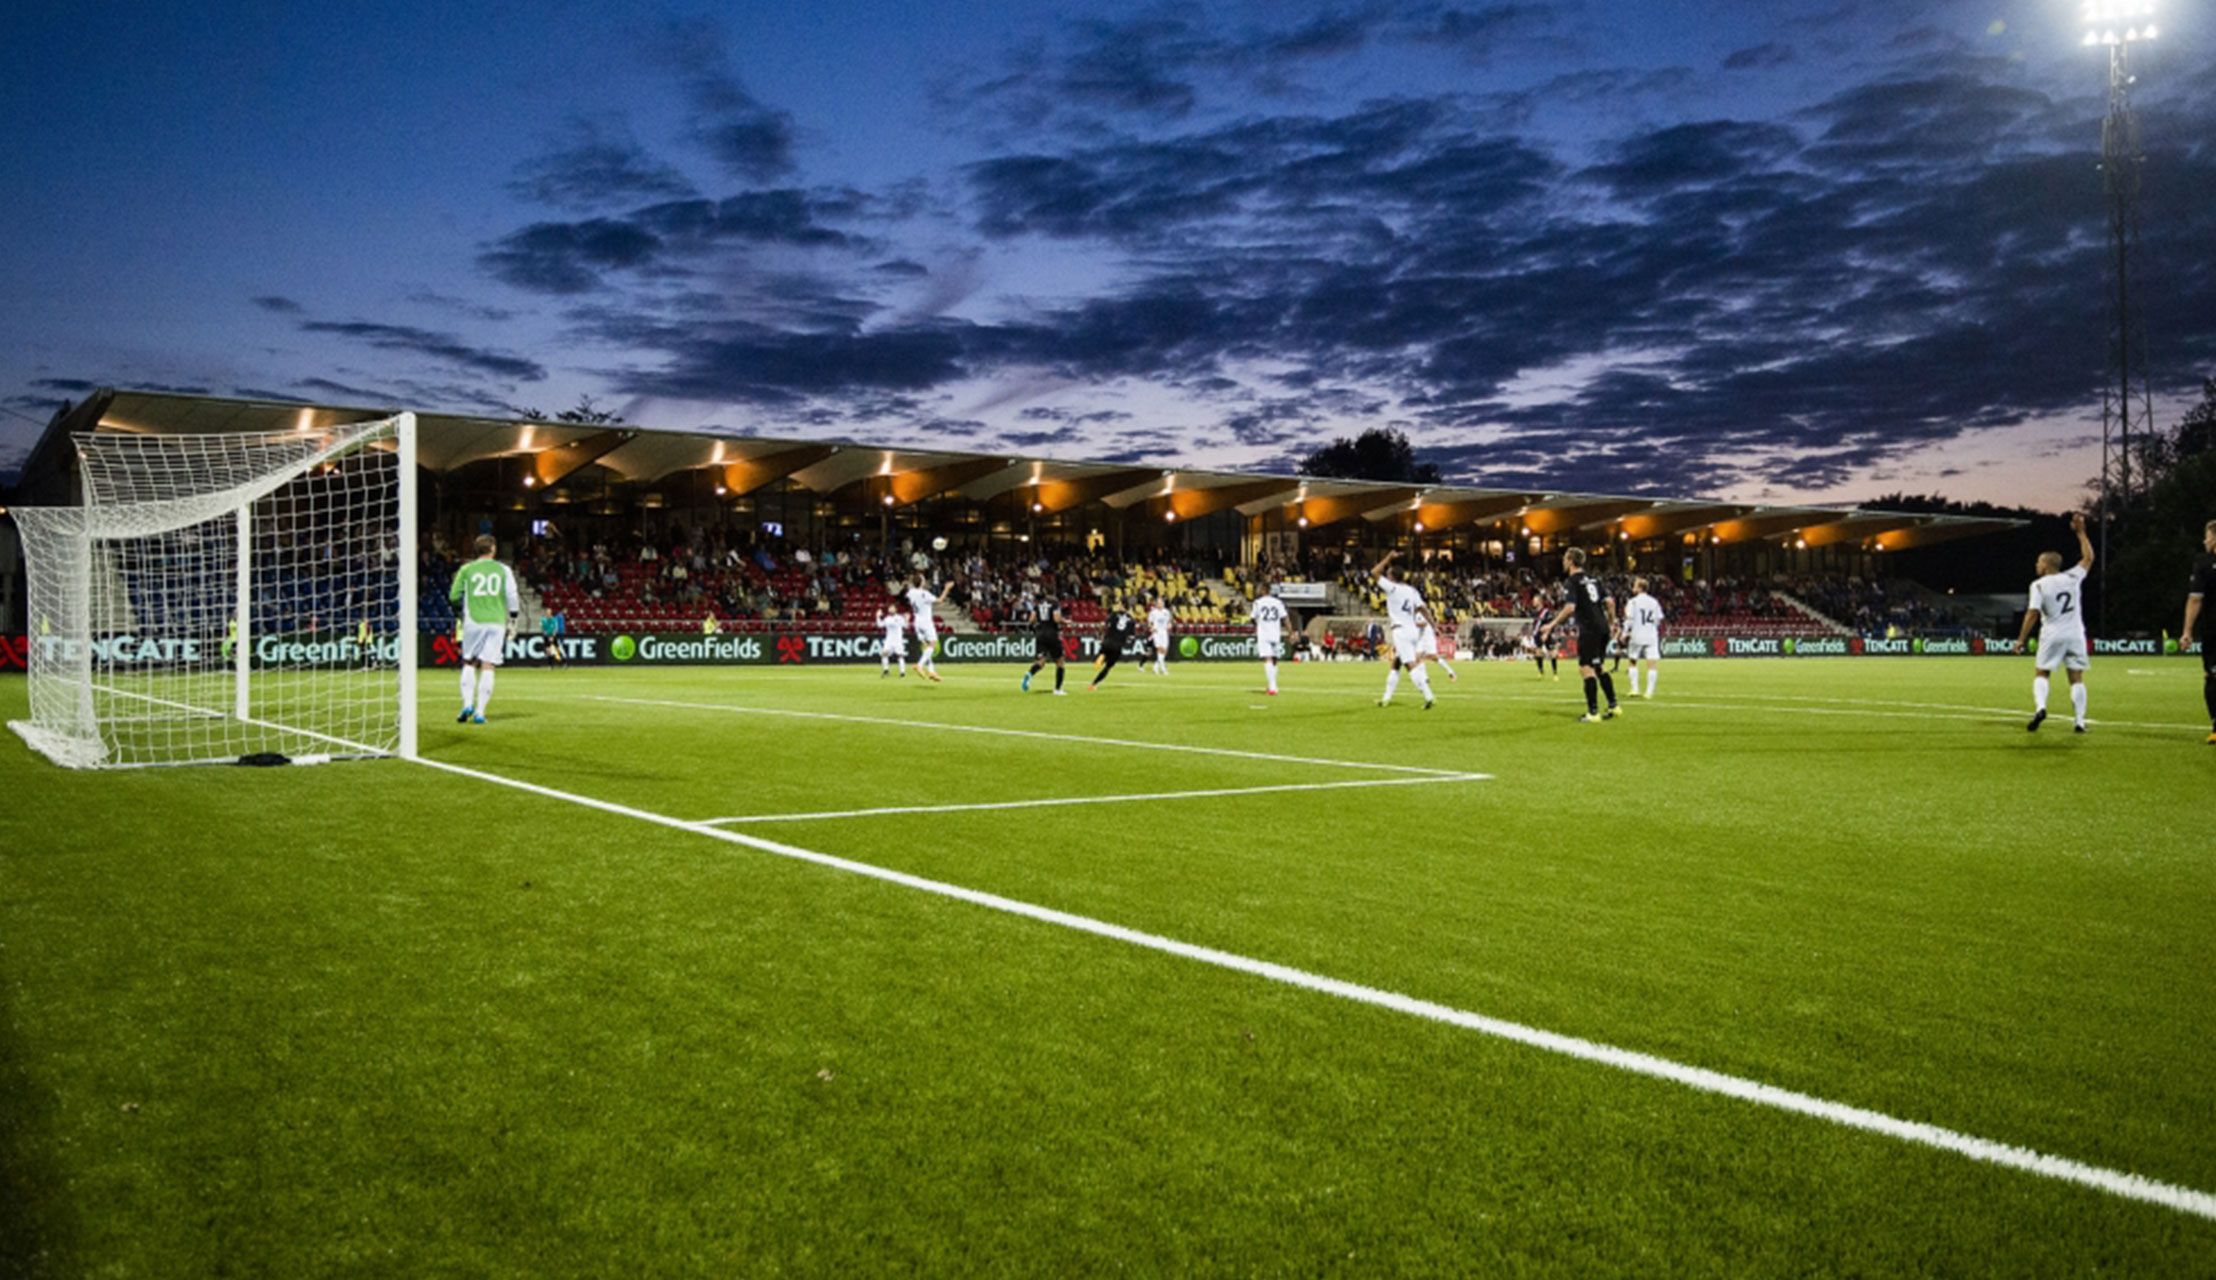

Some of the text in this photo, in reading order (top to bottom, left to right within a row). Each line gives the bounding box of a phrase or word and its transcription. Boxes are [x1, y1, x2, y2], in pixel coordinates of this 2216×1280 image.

[471, 573, 501, 596] 20
[1261, 606, 1279, 621] 23
[2056, 591, 2074, 614] 2
[1640, 608, 1654, 625] 14
[639, 636, 761, 659] GreenFields
